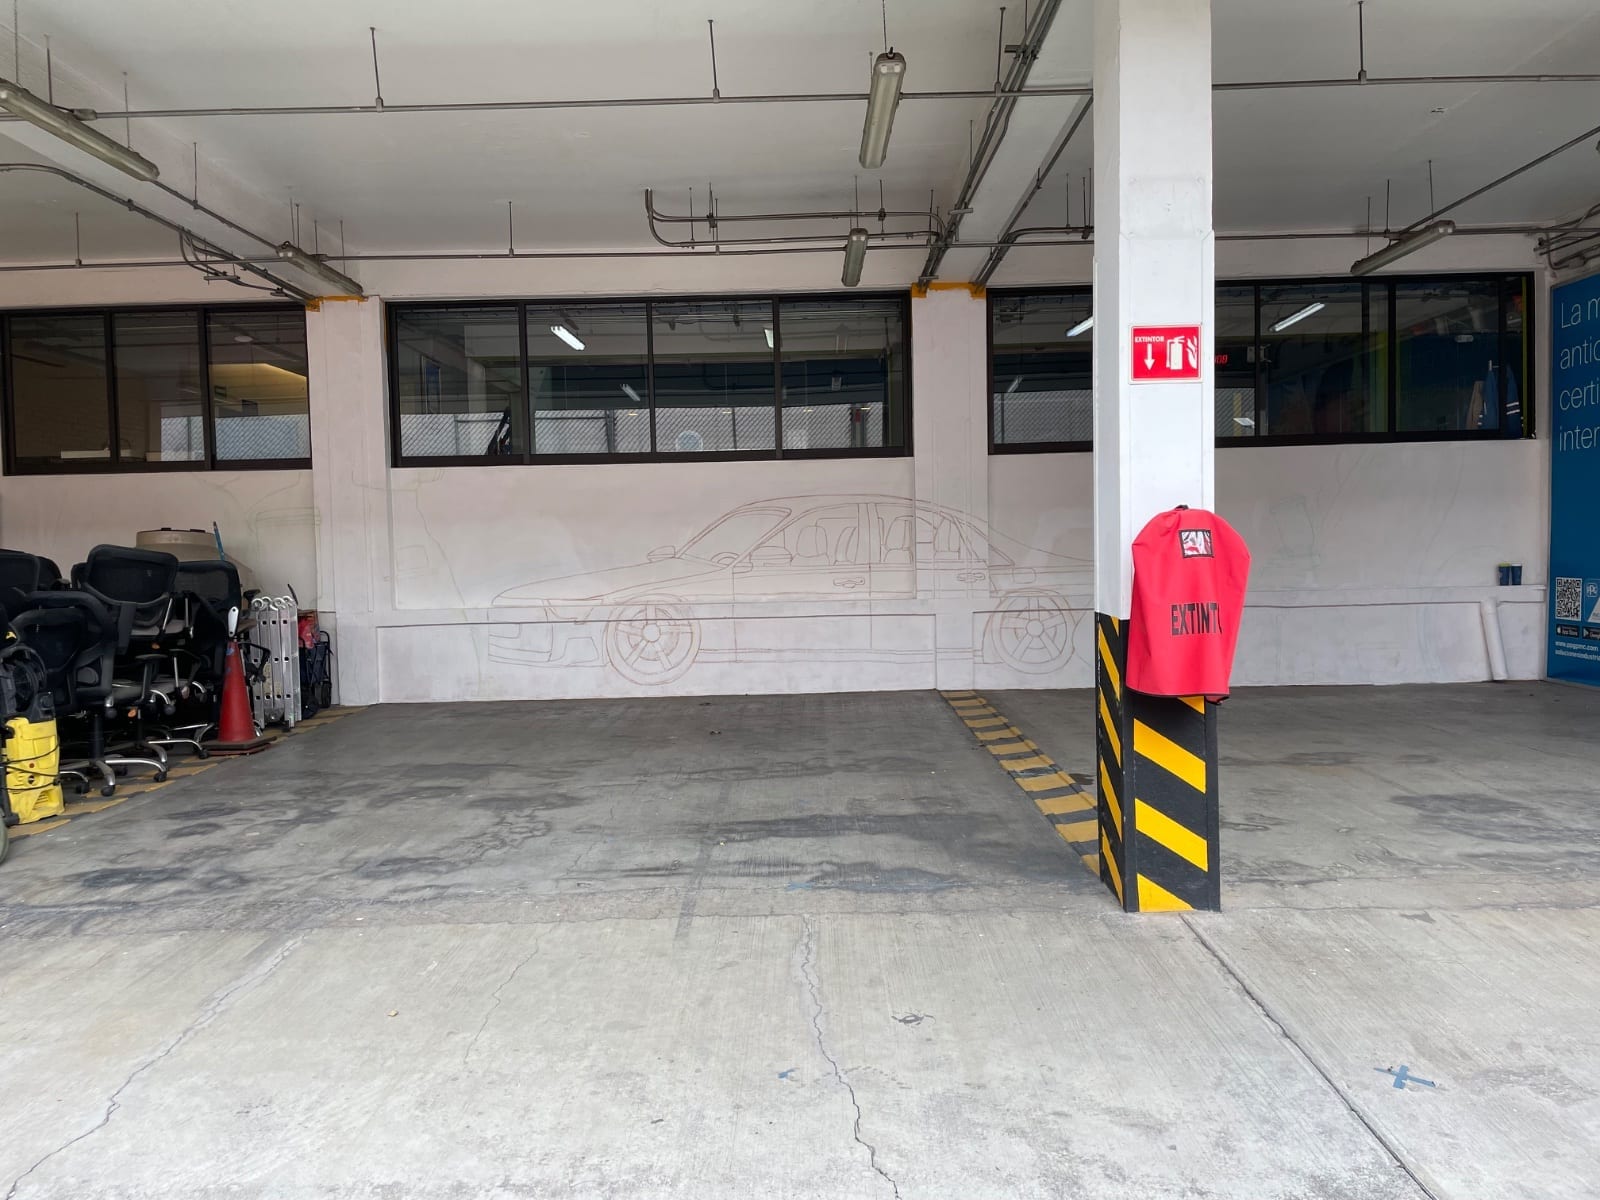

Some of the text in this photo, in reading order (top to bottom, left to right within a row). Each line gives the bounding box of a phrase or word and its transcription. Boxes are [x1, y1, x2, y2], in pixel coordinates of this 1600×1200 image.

[1560, 303, 1582, 329] La
[1134, 335, 1165, 343] EXTINTOR
[1559, 377, 1600, 411] certi
[1171, 602, 1223, 636] EXTINT
